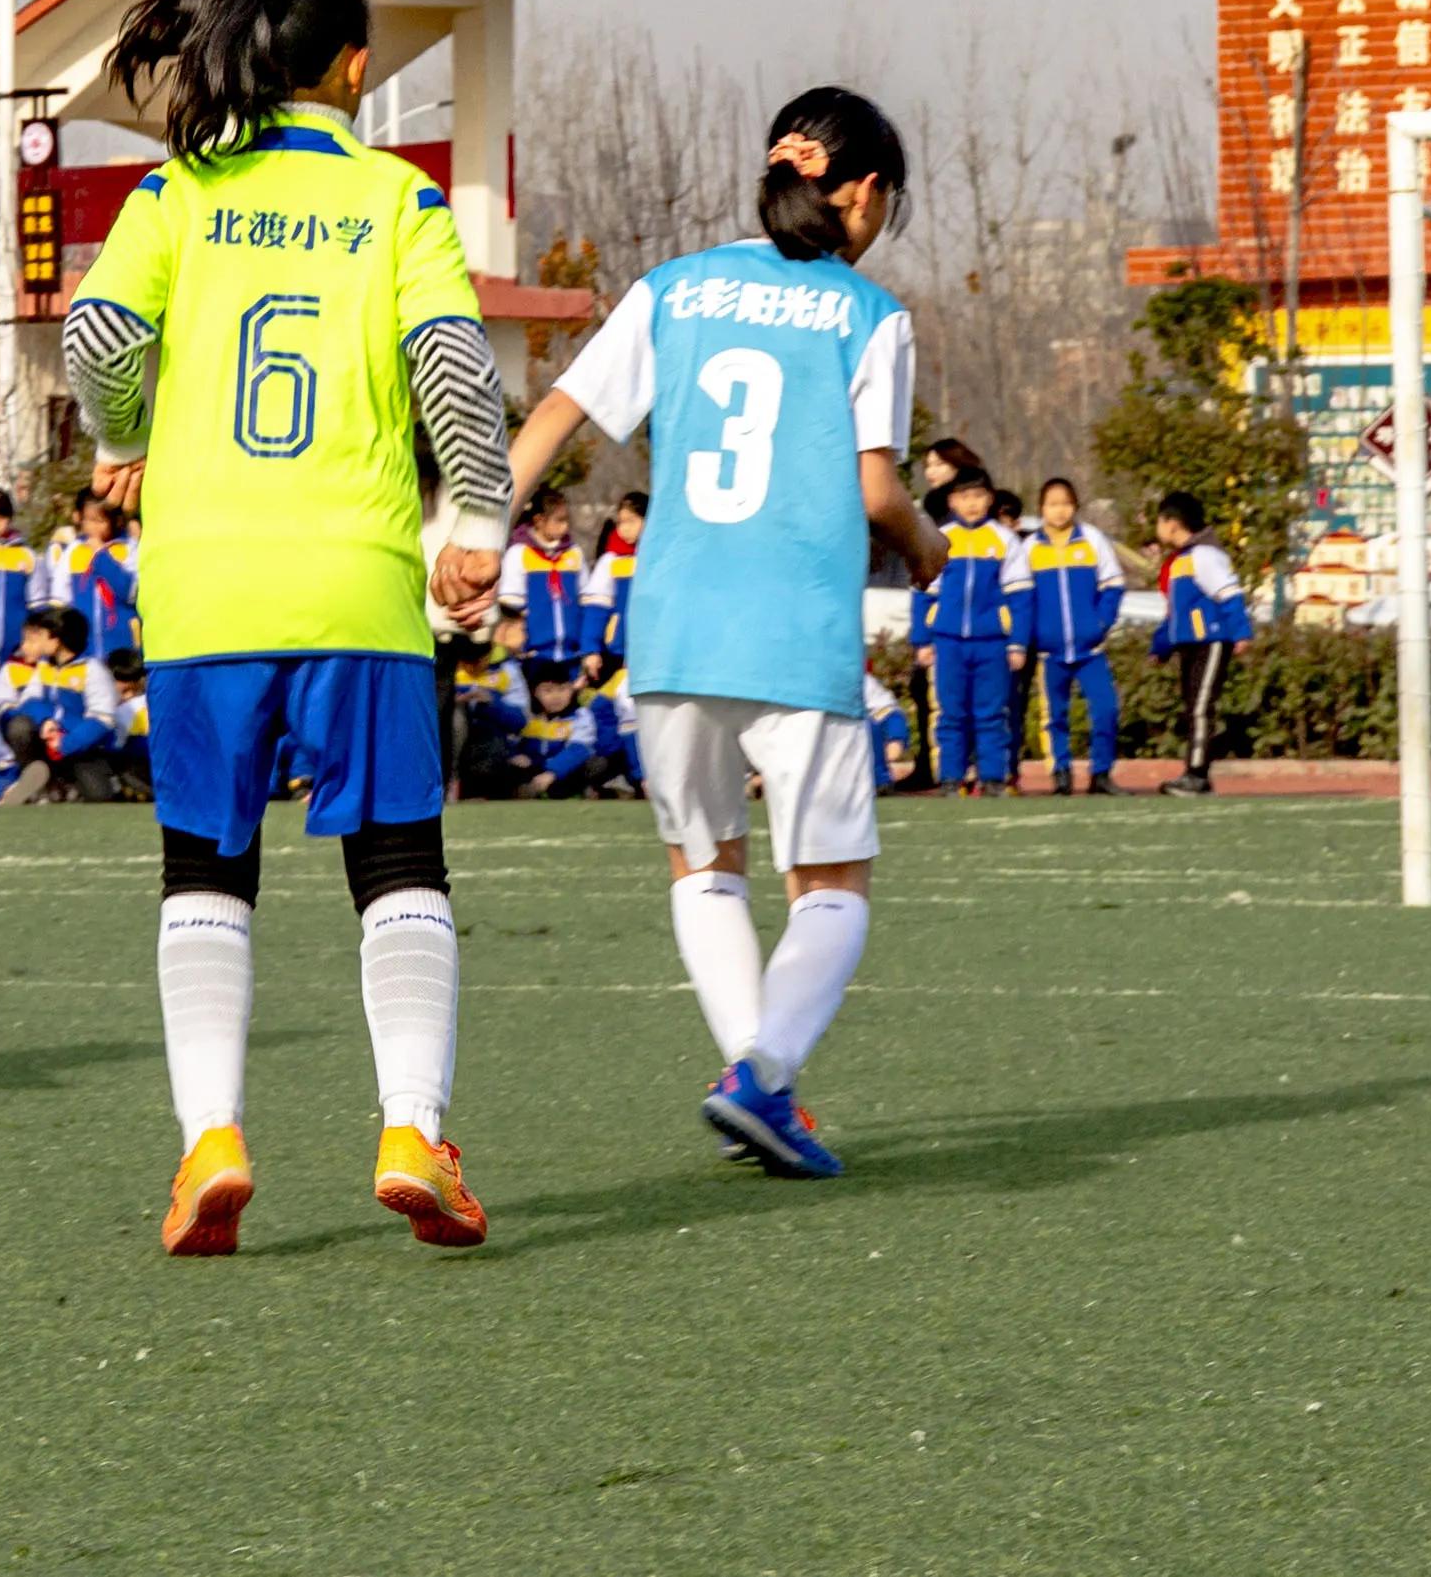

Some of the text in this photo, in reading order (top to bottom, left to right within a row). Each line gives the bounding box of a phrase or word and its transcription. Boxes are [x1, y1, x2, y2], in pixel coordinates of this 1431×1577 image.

[205, 207, 374, 255] 北渡小学
[664, 277, 853, 338] 七彩阳光队
[233, 293, 317, 460] 6
[685, 347, 784, 524] 3
